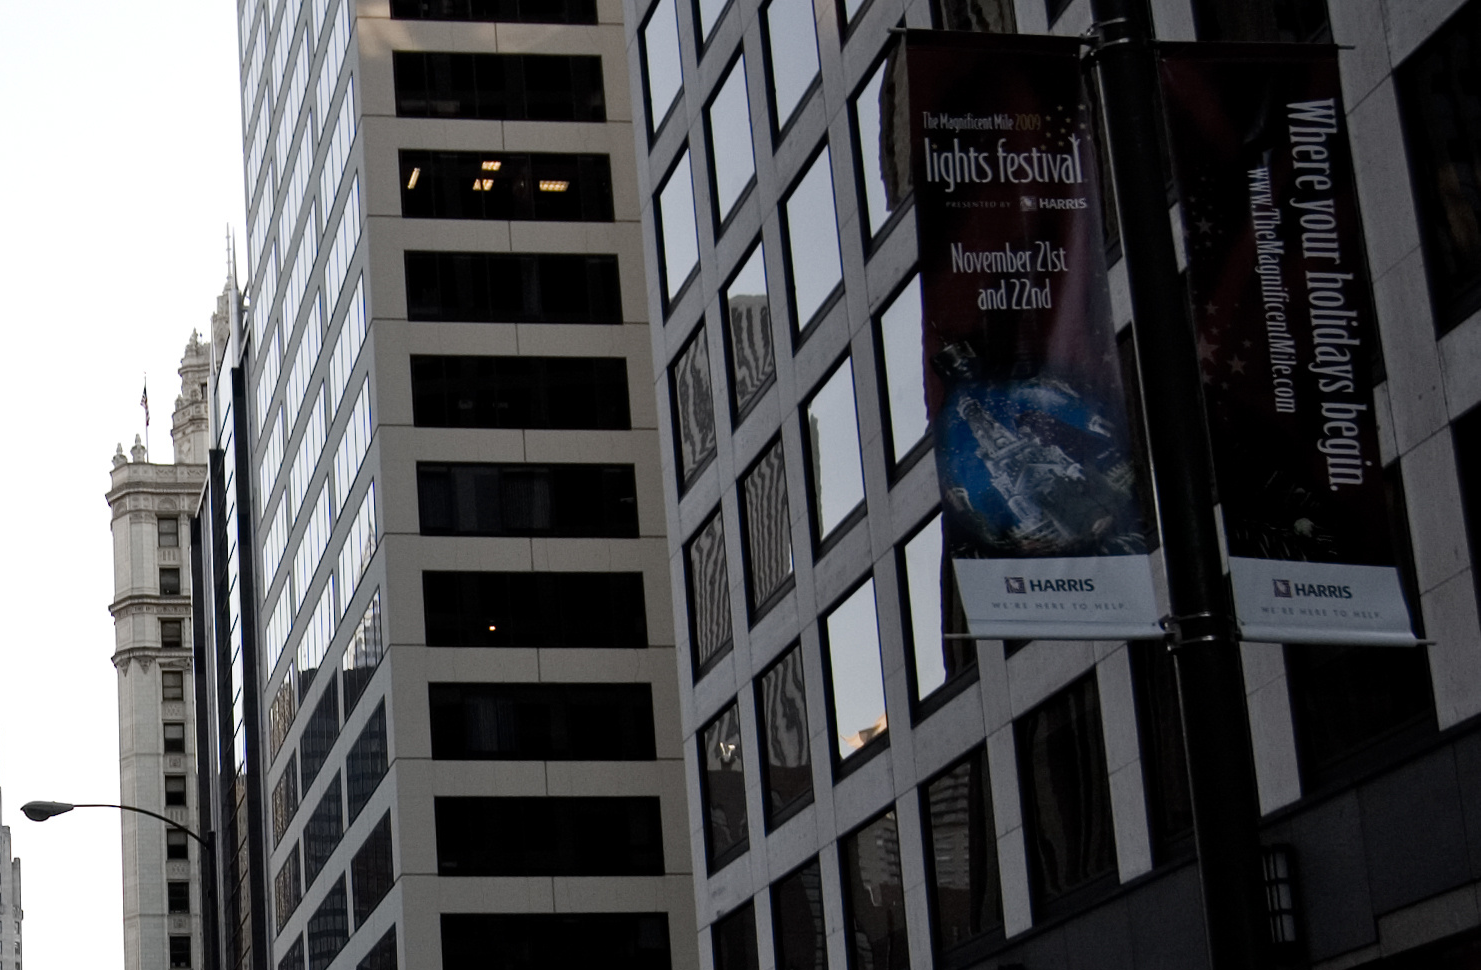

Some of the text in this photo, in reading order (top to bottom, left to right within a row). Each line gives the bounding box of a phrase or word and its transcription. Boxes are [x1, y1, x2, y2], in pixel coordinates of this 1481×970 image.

[923, 112, 1042, 133] The Magnificent Mile 2009
[923, 132, 1084, 194] lights festival
[944, 200, 1012, 209] PRESENTED BY
[1038, 197, 1088, 210] HARRIS
[949, 240, 1069, 274] November 21st
[976, 277, 1053, 311] and 22nd
[1246, 166, 1298, 414] www.TheMagnificentMile.com
[1285, 97, 1373, 492] Where your holidays begin.
[1029, 578, 1096, 593] HARRIS
[1293, 582, 1353, 599] HARRIS
[991, 602, 1029, 610] WE'RE
[1034, 602, 1065, 610] HERE
[1071, 602, 1088, 611] TO
[1299, 608, 1327, 617] HERE
[1332, 609, 1348, 617] TO
